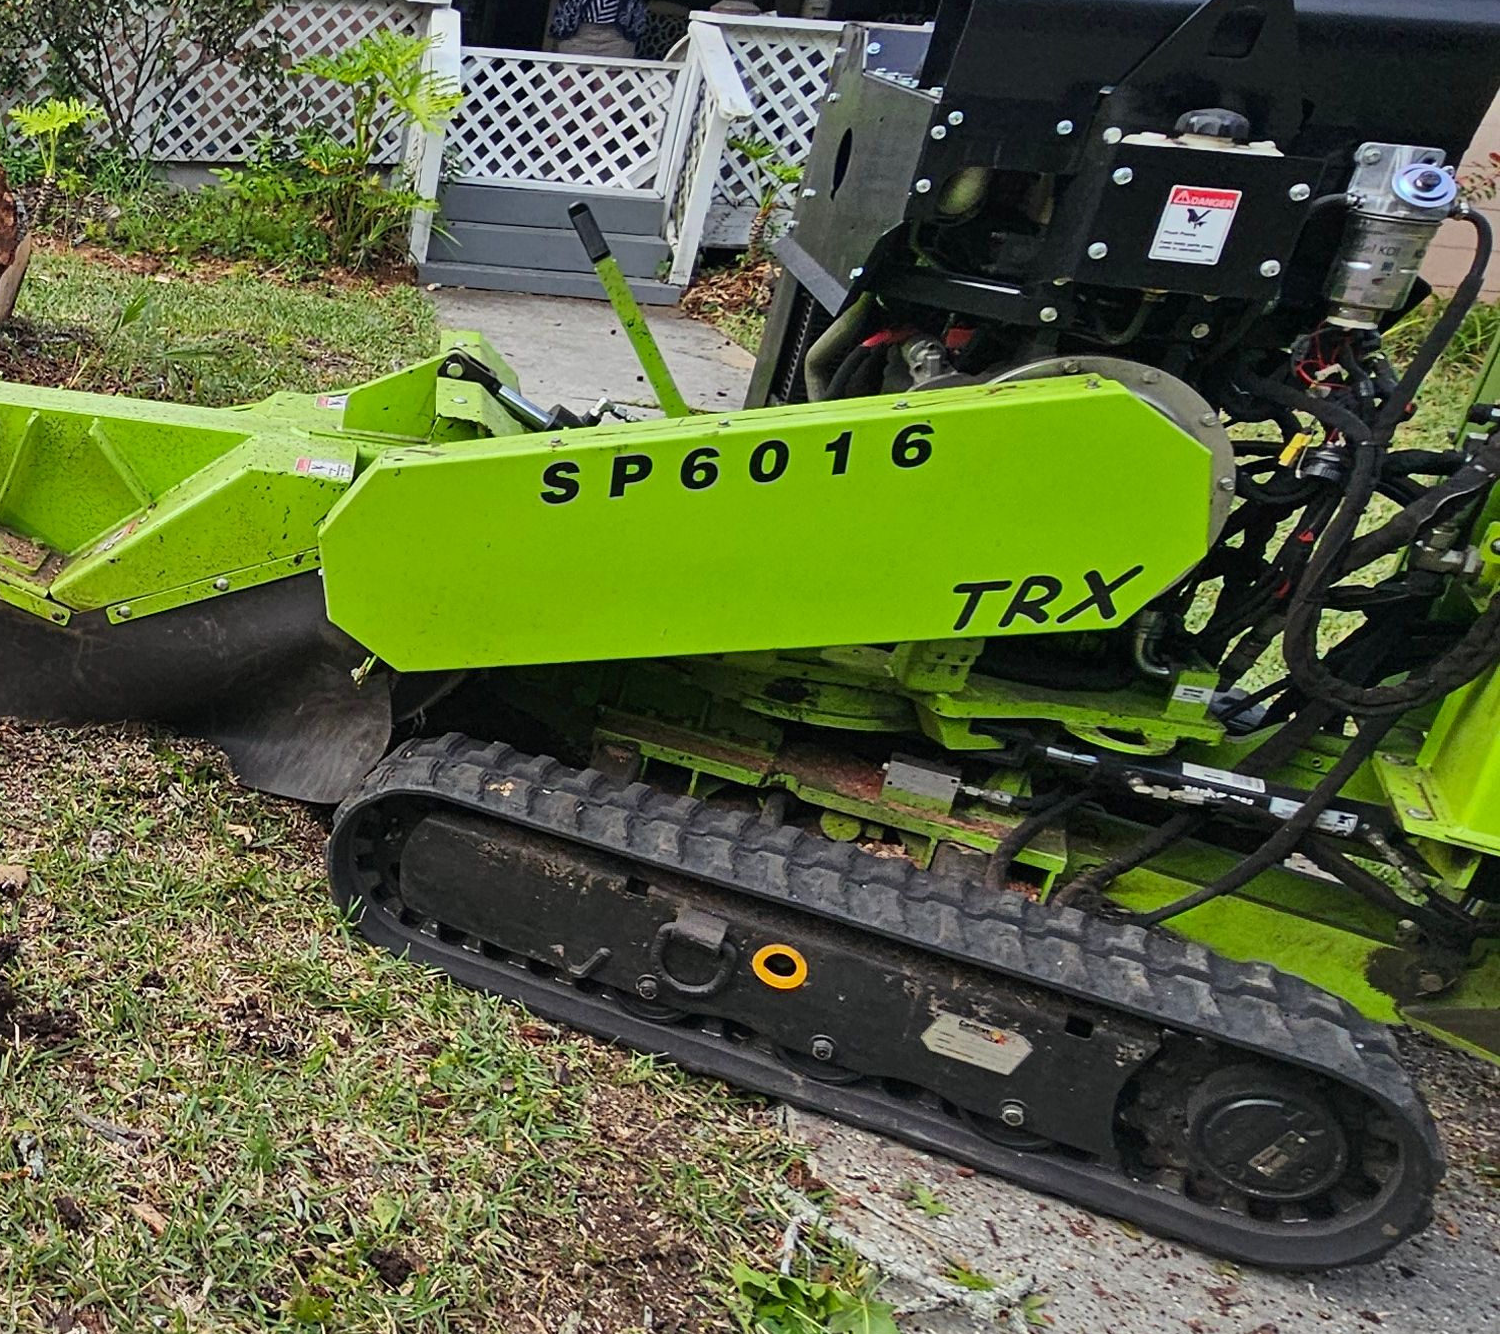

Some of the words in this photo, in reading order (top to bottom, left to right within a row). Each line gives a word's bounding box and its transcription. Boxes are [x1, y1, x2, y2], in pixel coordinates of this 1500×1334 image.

[1190, 196, 1235, 209] DANGER
[540, 422, 935, 504] SP6016
[953, 565, 1144, 631] TRX
